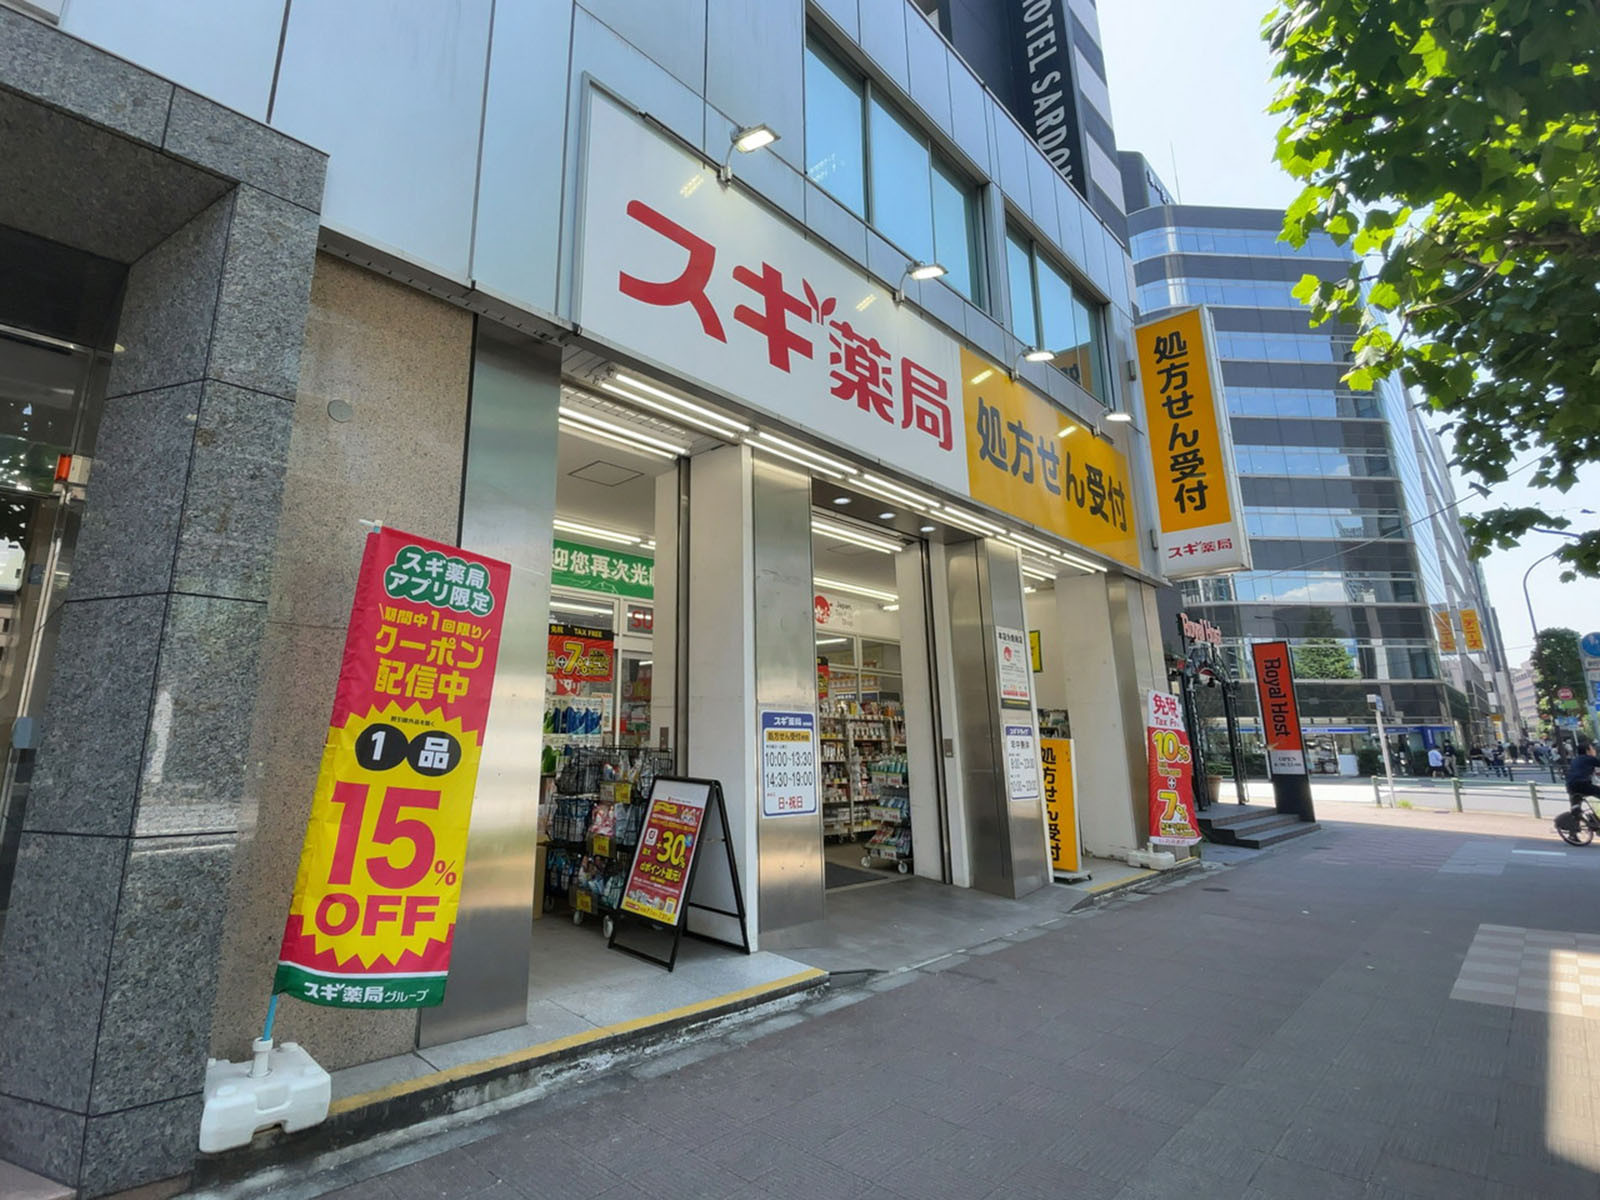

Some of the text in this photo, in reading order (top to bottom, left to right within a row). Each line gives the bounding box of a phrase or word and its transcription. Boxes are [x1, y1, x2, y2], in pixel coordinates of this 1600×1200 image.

[1022, 0, 1058, 73] OTEL
[619, 200, 953, 451] スギ薬局
[1154, 331, 1208, 514] 処方せん受付
[977, 397, 1127, 532] 処方せん受付
[1168, 538, 1233, 559] スギ薬局
[402, 552, 486, 589] スギ薬局
[388, 571, 489, 613] アプリ限定
[384, 606, 482, 639] 期間中1回限り
[574, 628, 587, 637] TAX
[588, 630, 602, 638] FREE
[375, 624, 484, 669] クーポン
[374, 658, 469, 703] 配信中
[1264, 657, 1287, 699] Royal
[1153, 694, 1179, 718] 免税
[1154, 717, 1167, 726] Tax
[1270, 702, 1291, 737] Host
[315, 893, 440, 937] OFF
